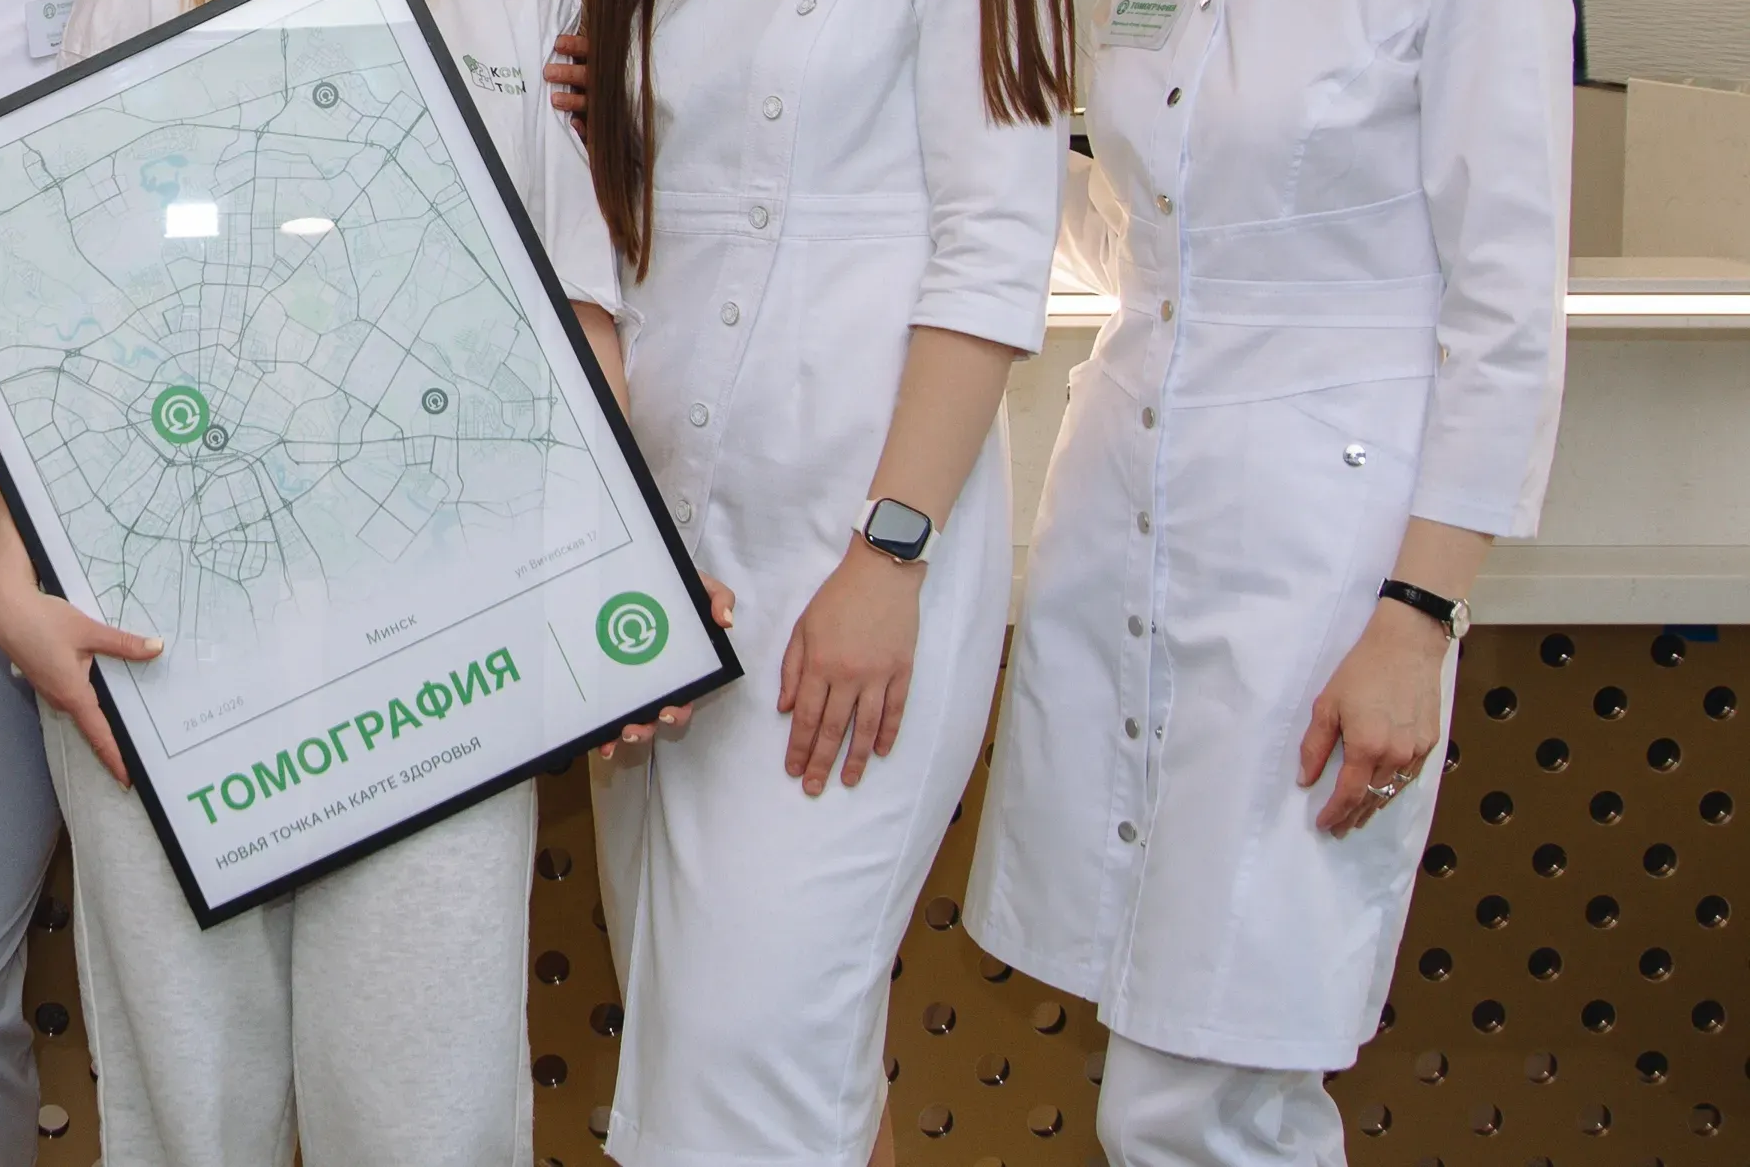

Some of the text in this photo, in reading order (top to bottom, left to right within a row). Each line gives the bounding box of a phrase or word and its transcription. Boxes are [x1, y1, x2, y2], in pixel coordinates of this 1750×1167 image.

[365, 614, 417, 645] Минск
[186, 646, 522, 825] ТОМОГРАФИЯ
[215, 736, 482, 870] НОВАЯ ТОЧКА НА КАРТЕ ЗДОРОВЬЯ
